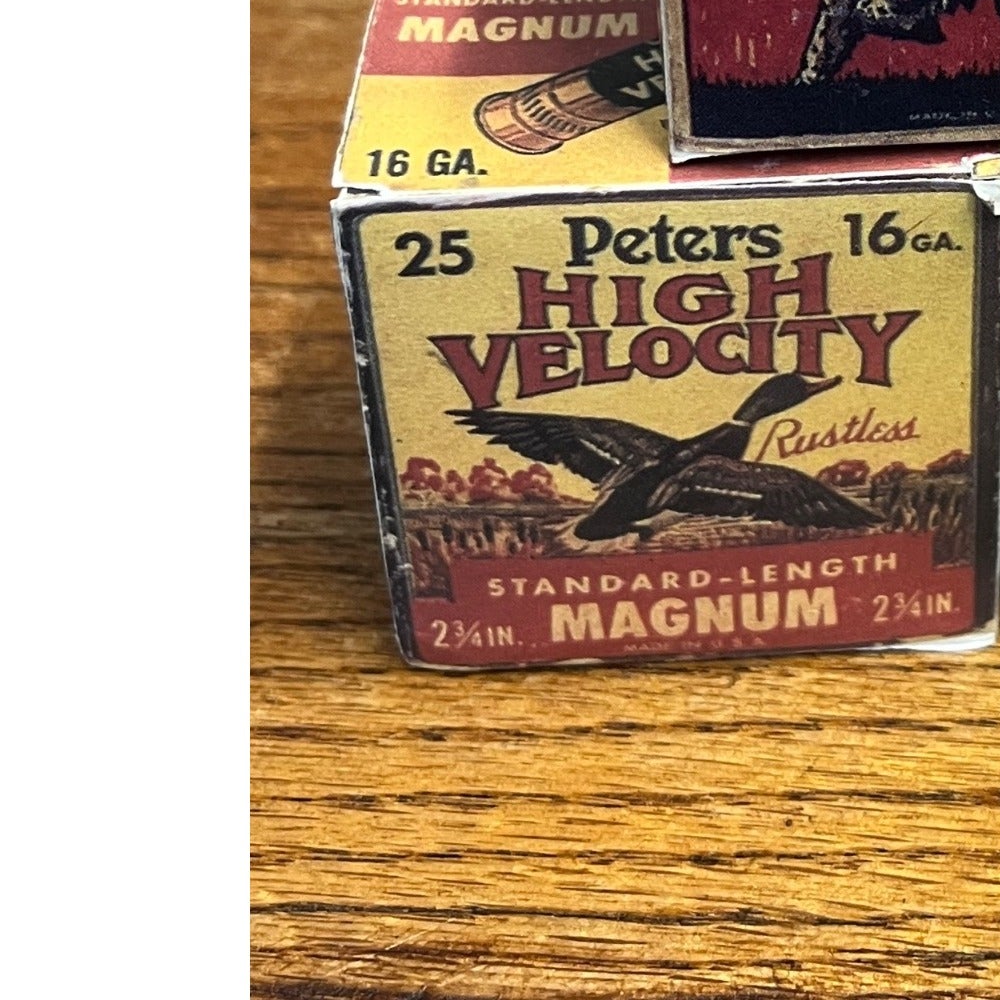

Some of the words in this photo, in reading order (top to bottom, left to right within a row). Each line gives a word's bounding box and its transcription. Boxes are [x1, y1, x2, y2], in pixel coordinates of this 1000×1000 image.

[397, 11, 639, 43] MAGNUM
[367, 148, 411, 177] 16
[426, 148, 489, 176] GA.
[394, 230, 475, 277] 25
[563, 213, 784, 268] Peters
[512, 252, 834, 330] HIGH
[427, 308, 922, 410] VELOCITY
[754, 407, 922, 463] Rustless
[488, 551, 900, 598] STANDARD-LENGTH
[550, 585, 838, 643] MAGNUM
